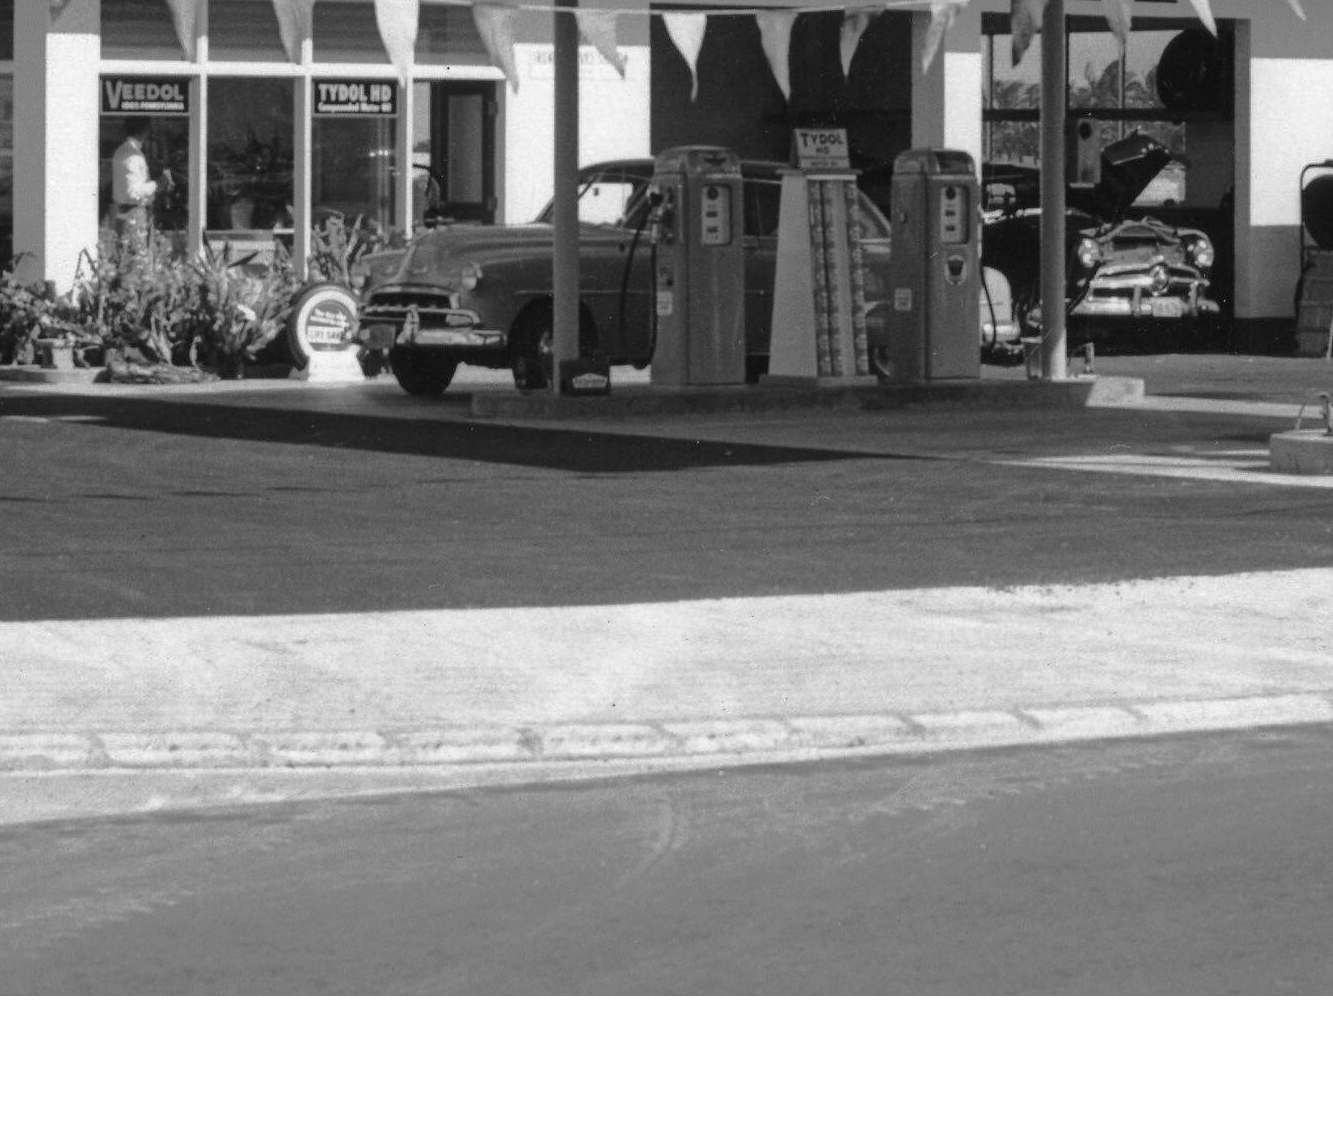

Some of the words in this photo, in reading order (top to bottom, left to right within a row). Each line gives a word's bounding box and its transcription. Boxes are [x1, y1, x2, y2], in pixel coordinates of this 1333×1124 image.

[105, 80, 185, 109] VEEDOL
[318, 83, 368, 102] TYDOL
[370, 84, 392, 103] HD
[799, 132, 845, 147] TYDOL
